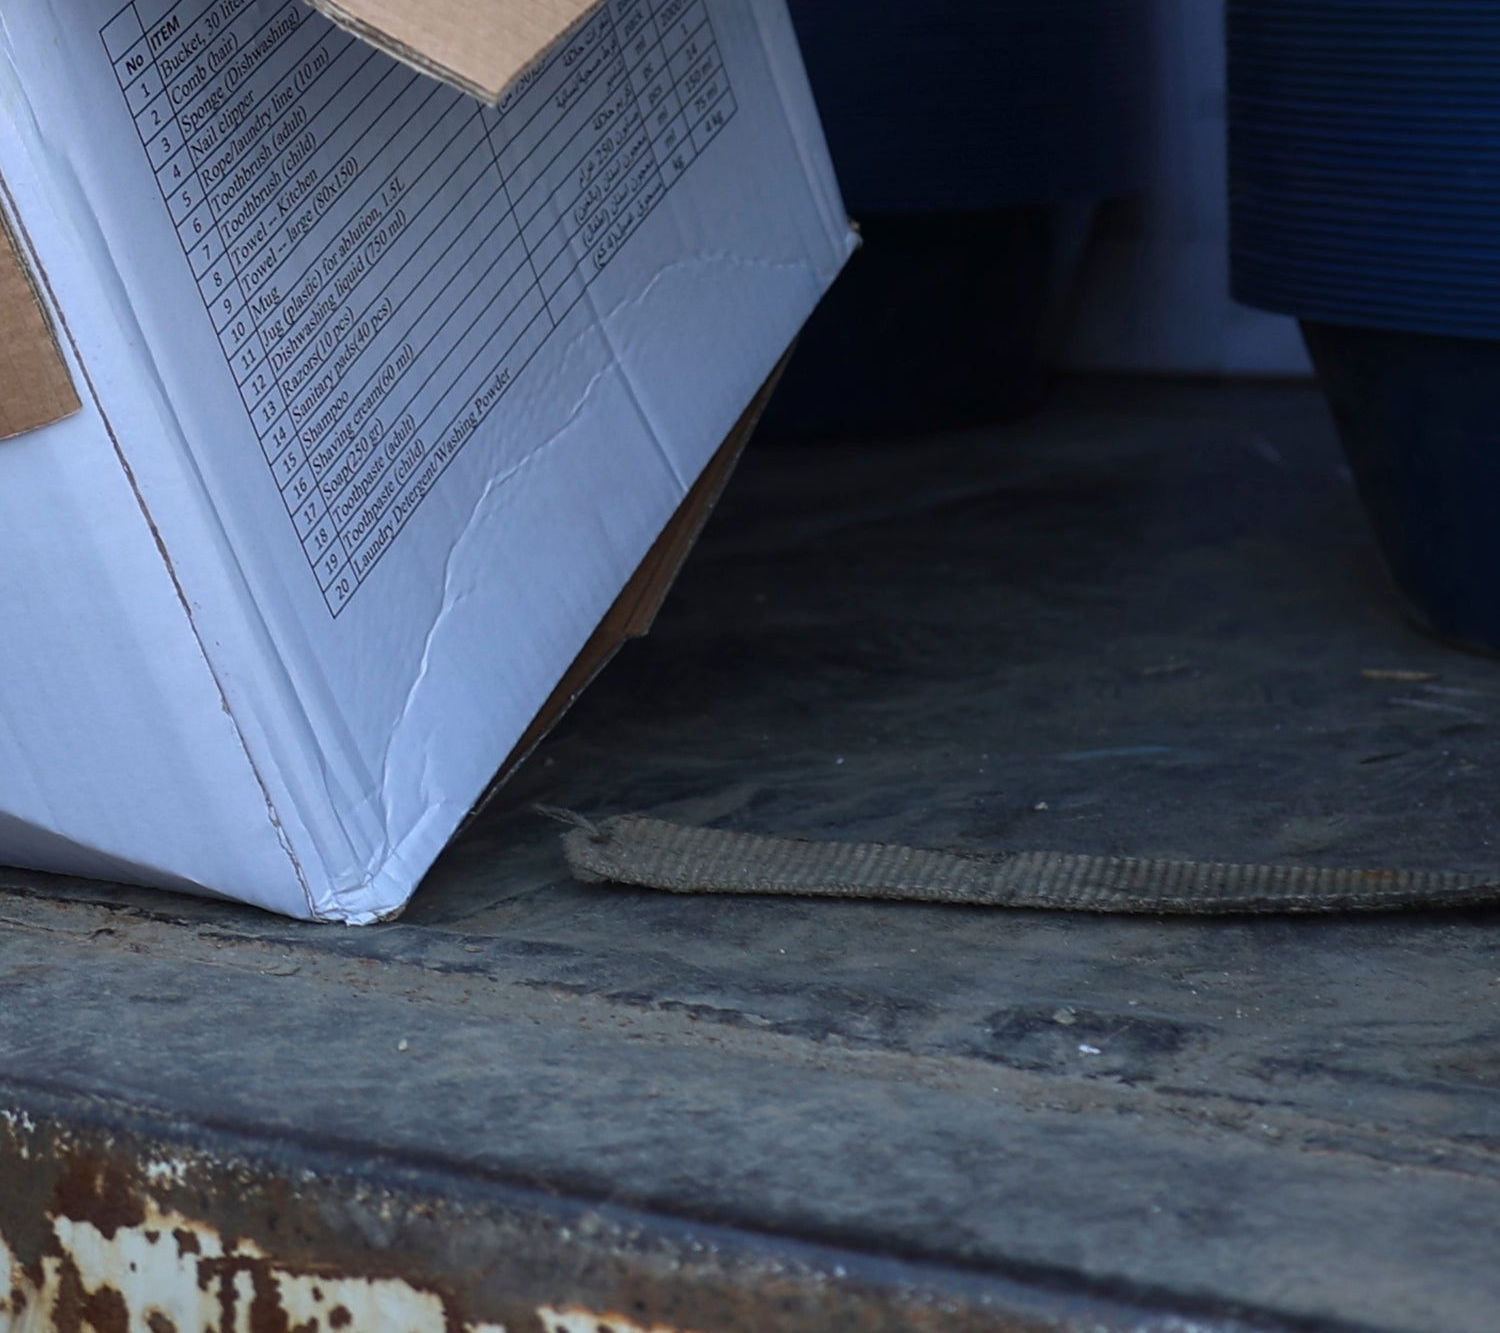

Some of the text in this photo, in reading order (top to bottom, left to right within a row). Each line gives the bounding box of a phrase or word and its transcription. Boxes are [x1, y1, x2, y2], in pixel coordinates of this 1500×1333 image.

[125, 15, 180, 76] No ITEM
[140, 81, 151, 98] 1
[160, 32, 203, 79] Bucket,
[204, 11, 221, 36] 30
[150, 31, 239, 126] 2 Comb (hair)
[160, 6, 300, 153] 3 Sponge (Dishwashing)
[170, 90, 257, 181] 4 Nail clipper
[181, 46, 330, 208] 5 Rope/laundry line (10 m)
[192, 105, 307, 235] 6 Toothbrush (adult)
[595, 137, 614, 166] 250
[202, 131, 317, 262] 7 Toothbrush (child)
[212, 270, 223, 288] 8
[231, 221, 268, 265] Towel
[276, 169, 318, 217] Kitchen
[222, 296, 233, 315] 9
[241, 247, 278, 292] Towel
[285, 209, 313, 244] large
[312, 156, 359, 216] (80x150)
[230, 286, 280, 344] 10 Mug
[240, 176, 405, 370] 11 Jug (plastic) for ablution, 1.5L
[251, 209, 407, 397] 12 Dishwashing liquid (750 ml)
[261, 306, 356, 423] 13 Razors(10 pcs)
[271, 297, 394, 448] 14 Sanitary pads(40 pcs)
[293, 343, 414, 500] 16 Shaving cream(60 ml)
[282, 391, 352, 474] 15 Shampoo
[303, 415, 385, 525] 17 Soap(250 gr)
[314, 413, 418, 551] 18 Toothpaste (adult)
[335, 367, 510, 601] 20 Laundry Detergent/Washing Powder
[324, 438, 427, 576] 19 Toothpaste (child)
